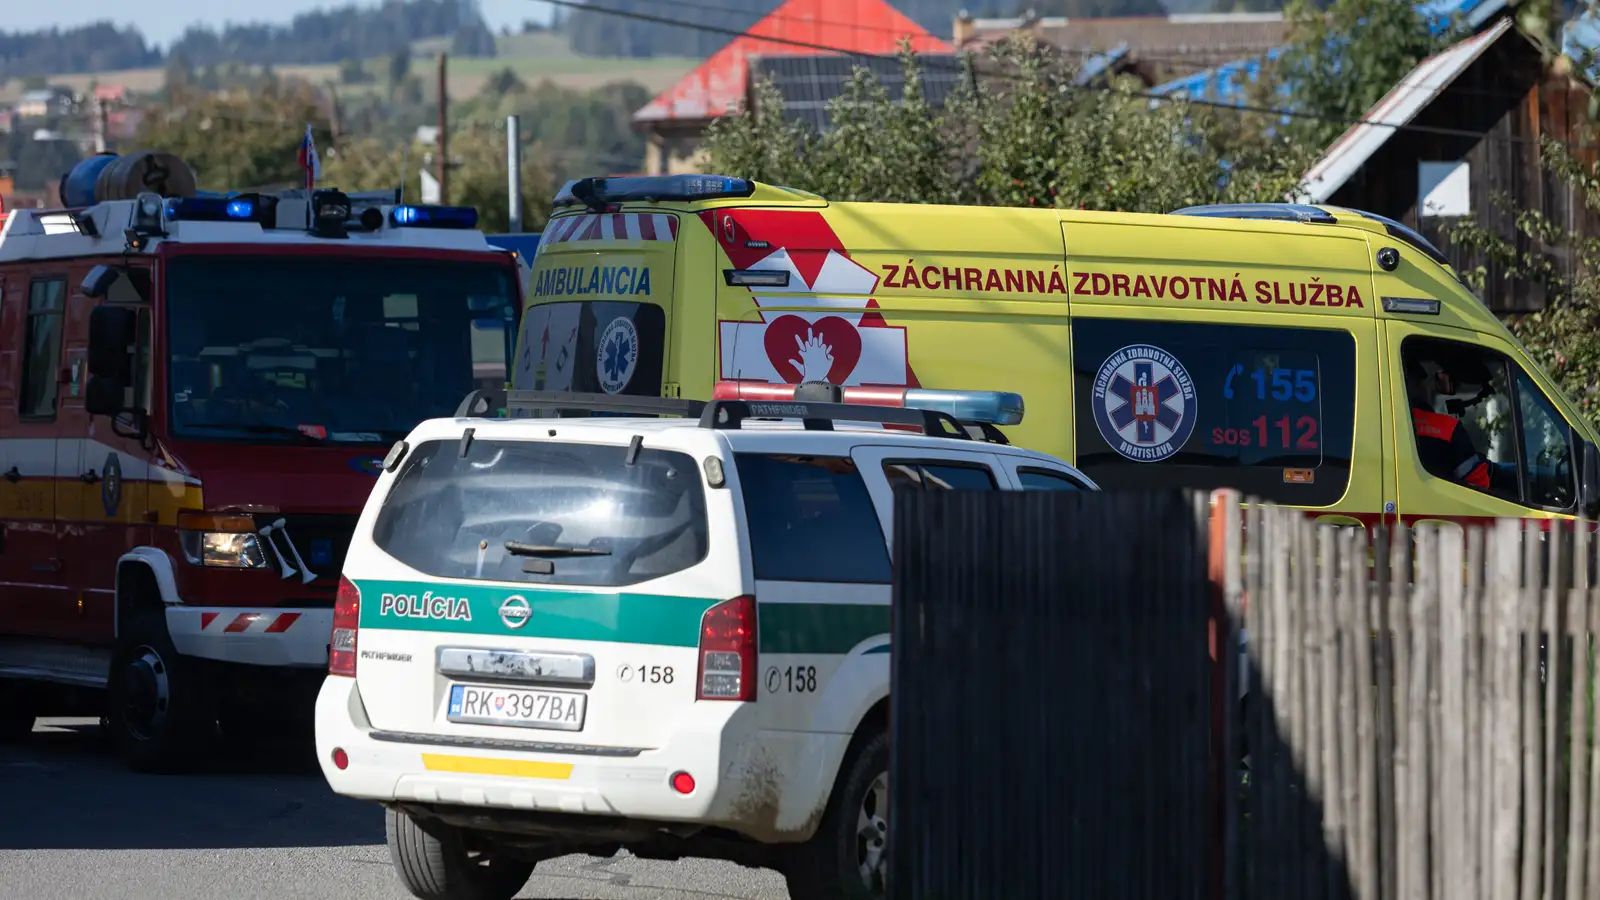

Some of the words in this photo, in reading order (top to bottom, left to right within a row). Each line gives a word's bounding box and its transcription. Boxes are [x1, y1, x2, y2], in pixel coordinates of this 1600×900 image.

[534, 266, 650, 297] AMBULANCIA
[882, 259, 1067, 294] ZÁCHRANNÁ
[1073, 272, 1248, 302] ZDRAVOTNÁ
[1255, 277, 1364, 308] SLUŽBA
[1095, 351, 1128, 399] ZÁCHRANNÁ
[1126, 348, 1175, 371] ZDRAVOTNÁ
[1173, 366, 1194, 400] SLUŽBA
[1250, 366, 1316, 403] 155
[751, 404, 809, 415] PATHFINDER
[1212, 427, 1251, 446] SOS
[1252, 414, 1318, 449] 112
[1119, 441, 1174, 459] BRATISLAVA
[380, 592, 472, 621] POLÍCIA
[638, 665, 674, 684] 158
[785, 665, 817, 693] 158
[464, 690, 494, 716] RK
[506, 693, 578, 722] 397BA
